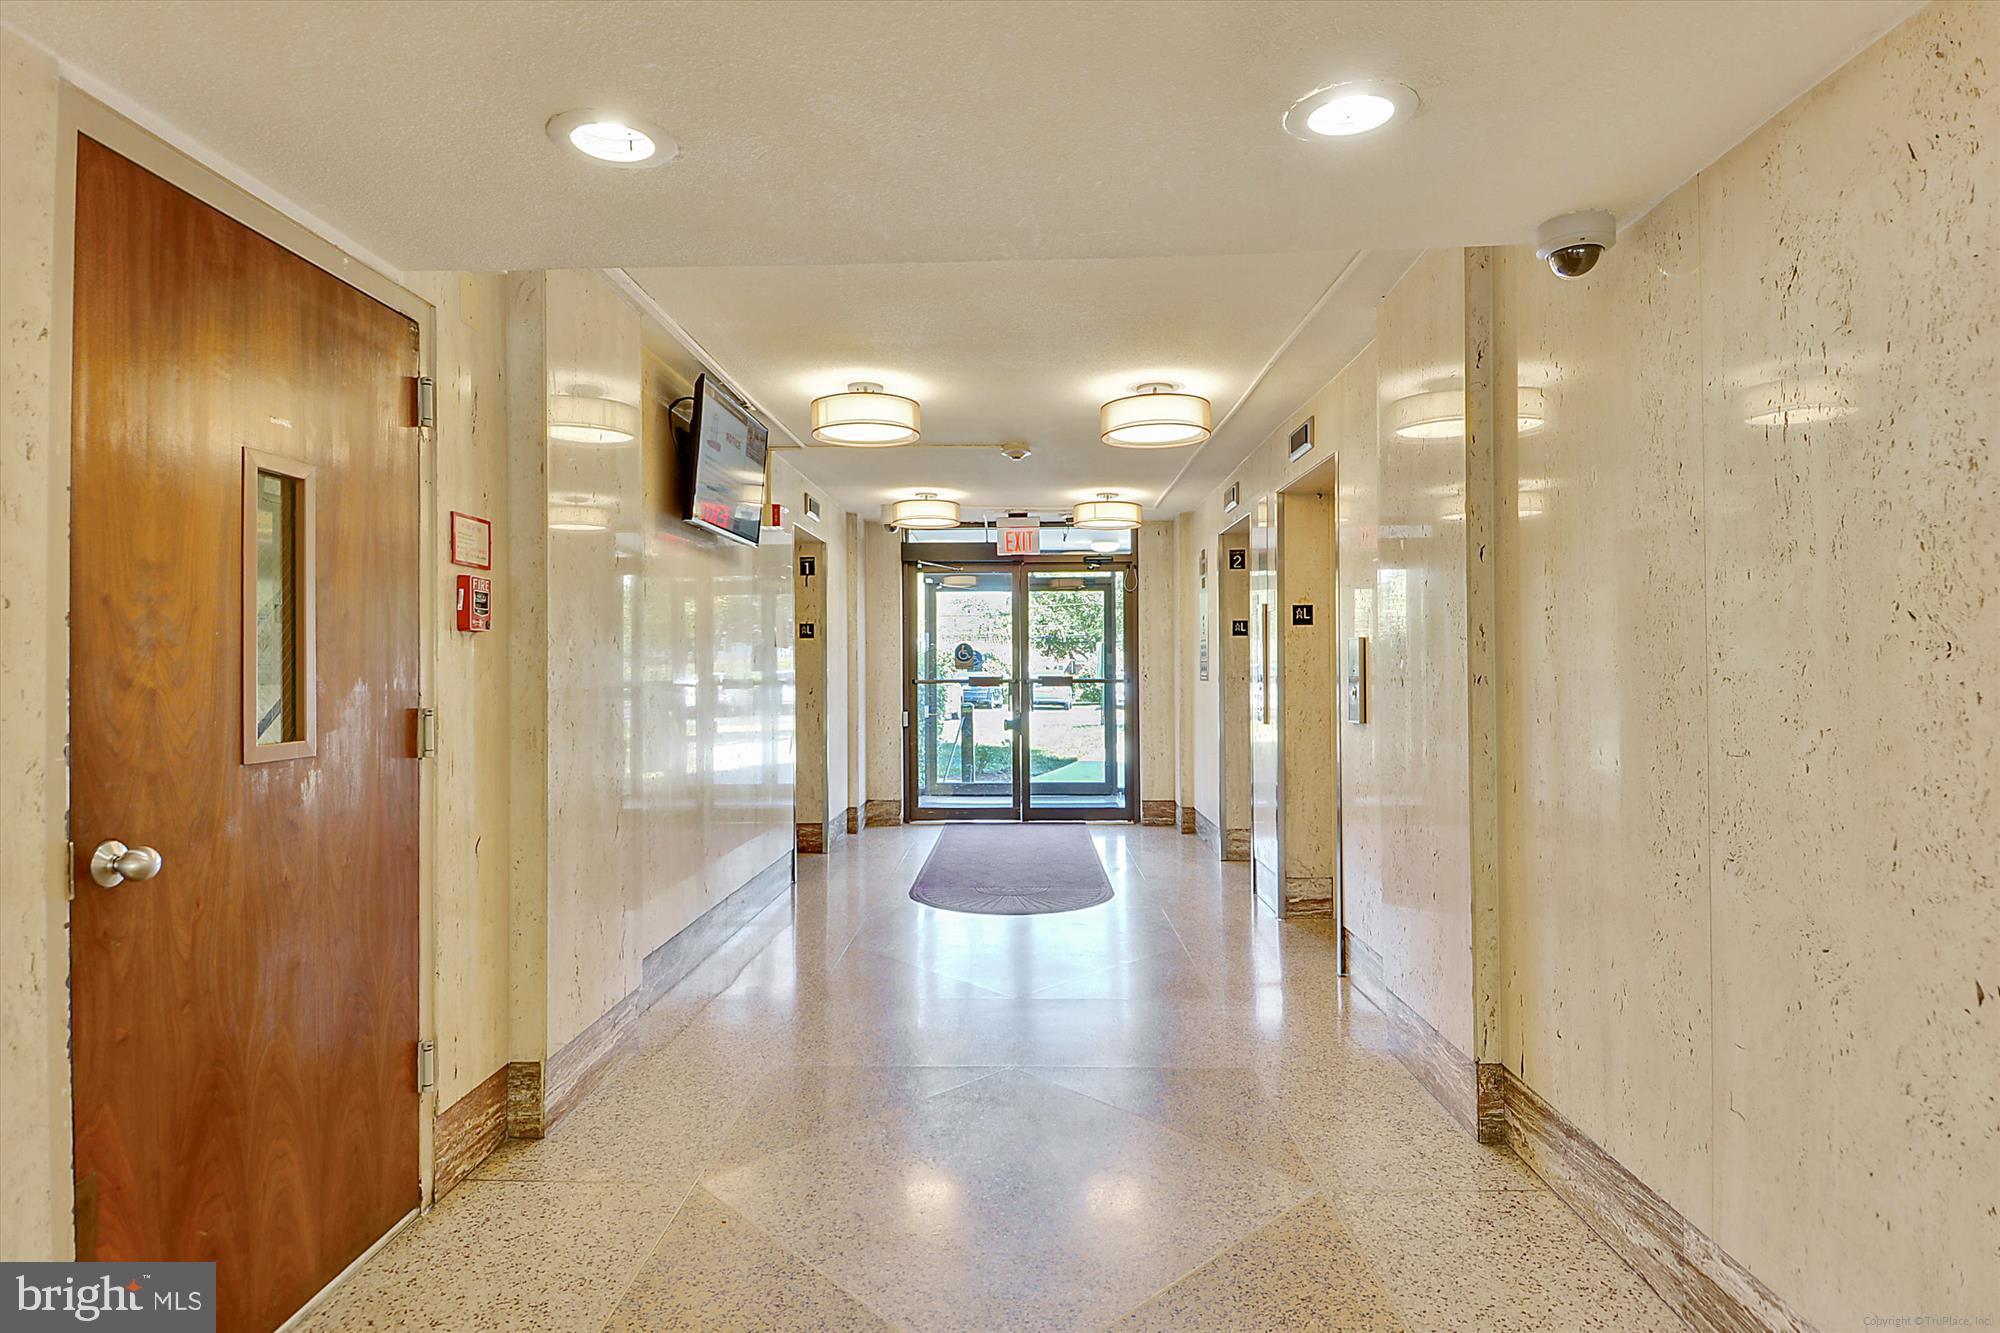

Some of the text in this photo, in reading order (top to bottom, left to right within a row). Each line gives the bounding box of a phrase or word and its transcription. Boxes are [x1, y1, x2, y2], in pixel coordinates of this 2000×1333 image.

[1005, 531, 1033, 552] EXIT
[804, 562, 809, 574] 1
[1233, 555, 1242, 568] 2
[472, 578, 490, 592] FIRE
